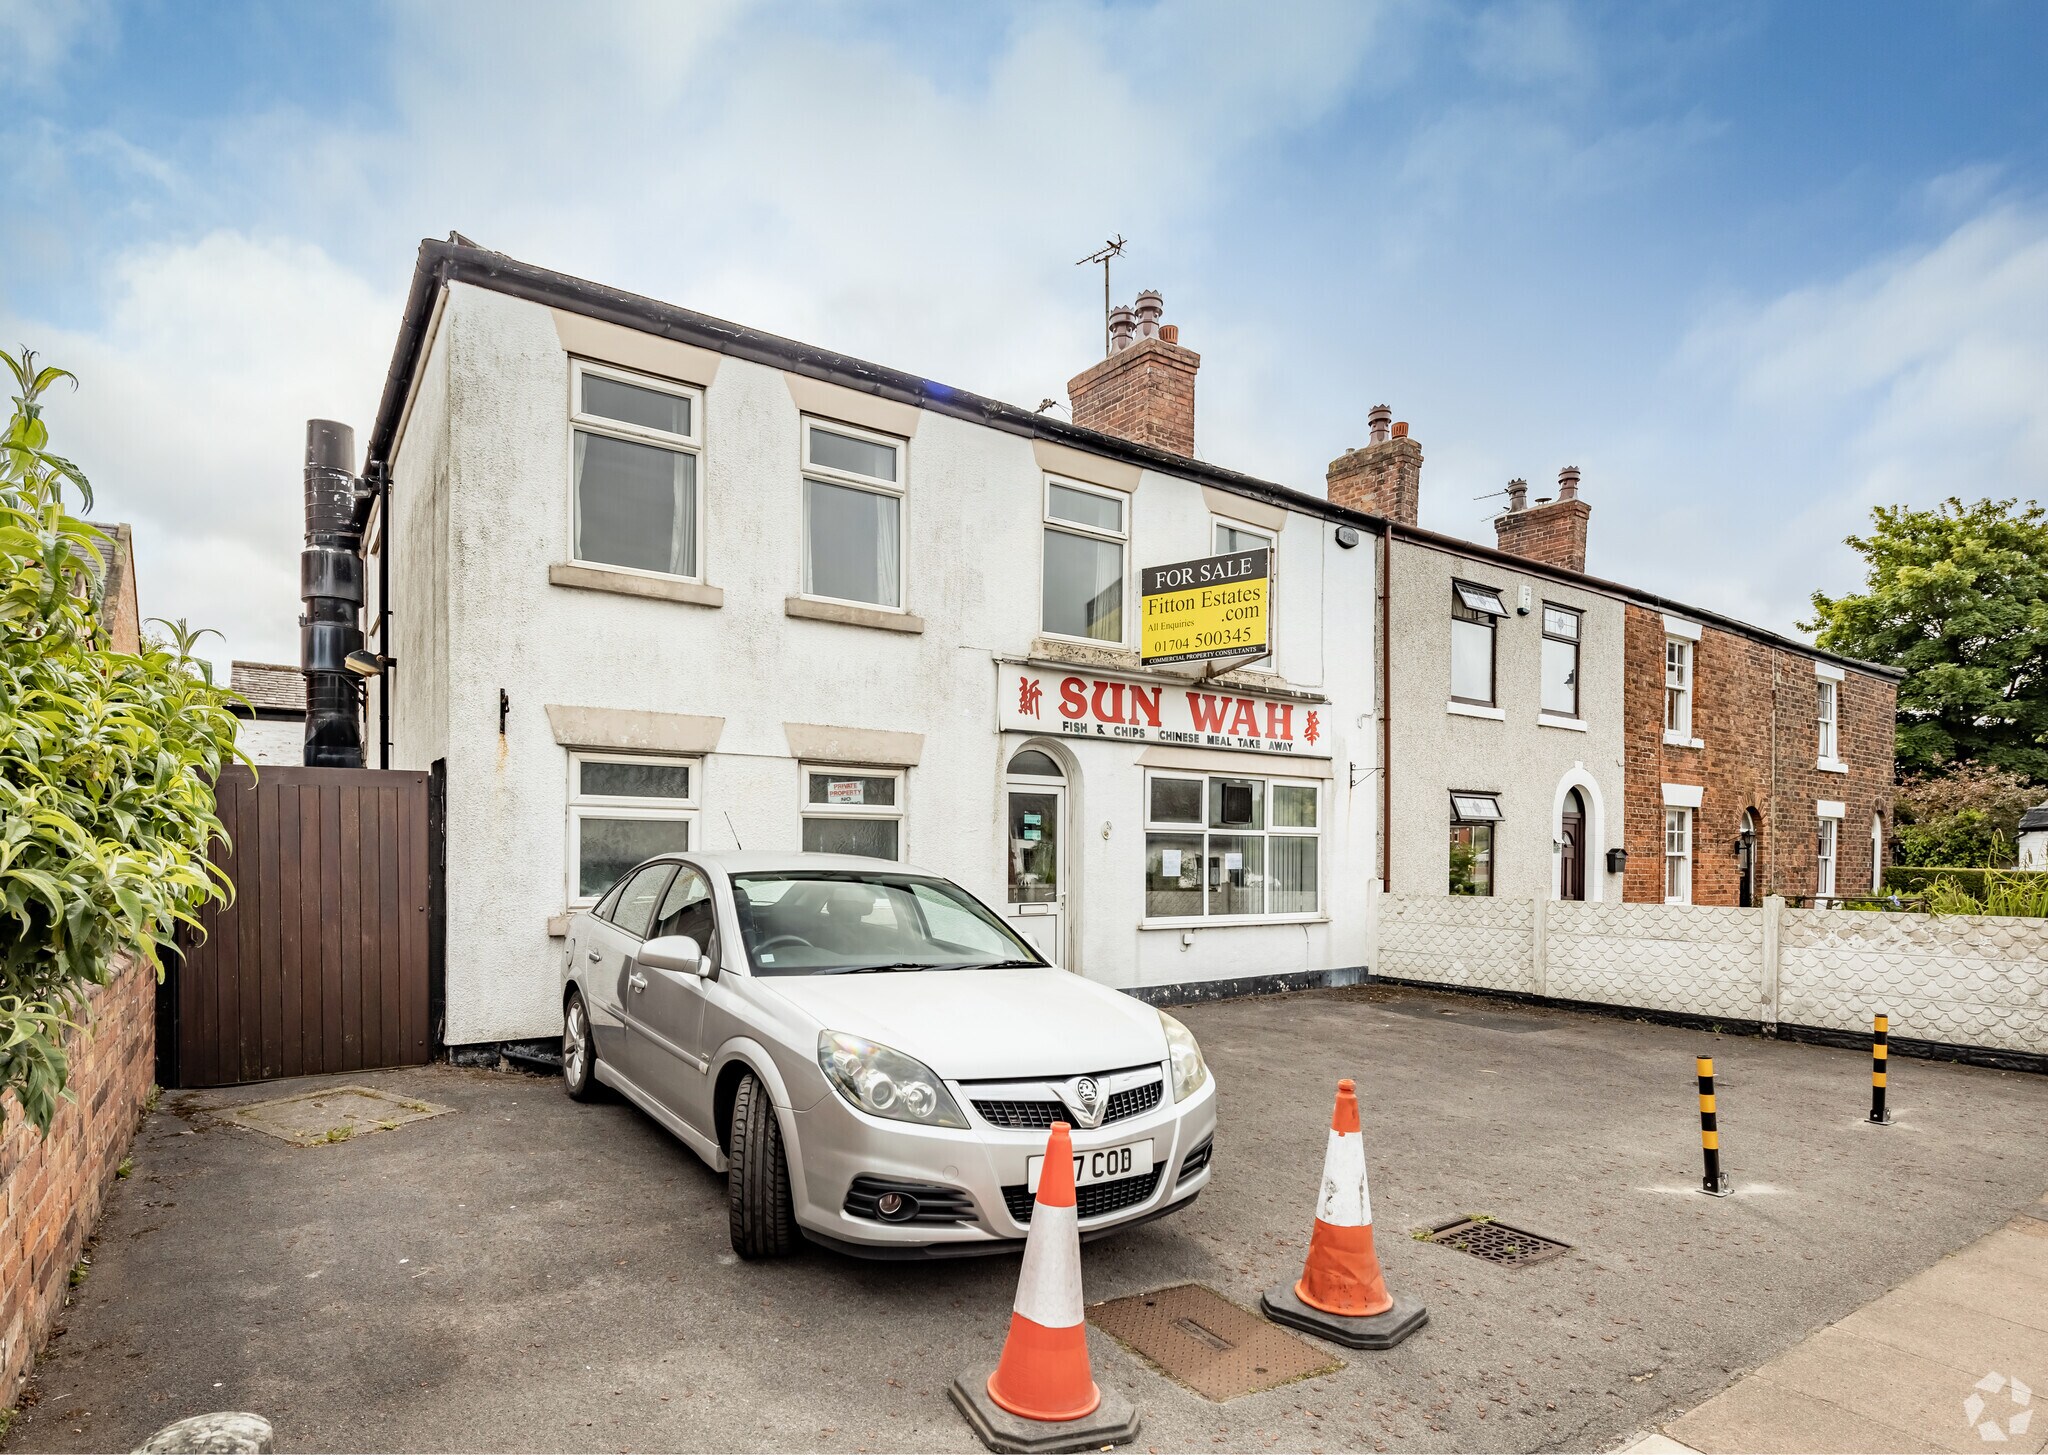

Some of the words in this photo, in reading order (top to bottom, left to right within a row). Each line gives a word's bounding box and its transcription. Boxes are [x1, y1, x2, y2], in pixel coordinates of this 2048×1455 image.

[1155, 567, 1195, 589] FOR
[1200, 557, 1253, 582] SALE
[1148, 597, 1195, 615] Fitton
[1201, 587, 1260, 608] Estates
[1221, 605, 1260, 622] .com
[1147, 623, 1159, 633] All
[1160, 619, 1195, 631] Enquiries
[1154, 638, 1189, 652] 01704
[1194, 626, 1252, 648] 500345
[1149, 655, 1185, 664] COMMERCIAL
[1186, 651, 1215, 660] PROPERTY
[1215, 646, 1257, 656] CONSULTANTS
[1058, 676, 1162, 727] SUN
[1186, 692, 1293, 740] WAH
[1062, 721, 1088, 733] FISH
[1096, 724, 1106, 735] &
[1113, 726, 1146, 739] CHIPS
[1159, 730, 1199, 743] CHINESE
[1206, 734, 1232, 747] MEAL
[1237, 738, 1261, 749] TAKE
[1268, 740, 1294, 752] AWAY
